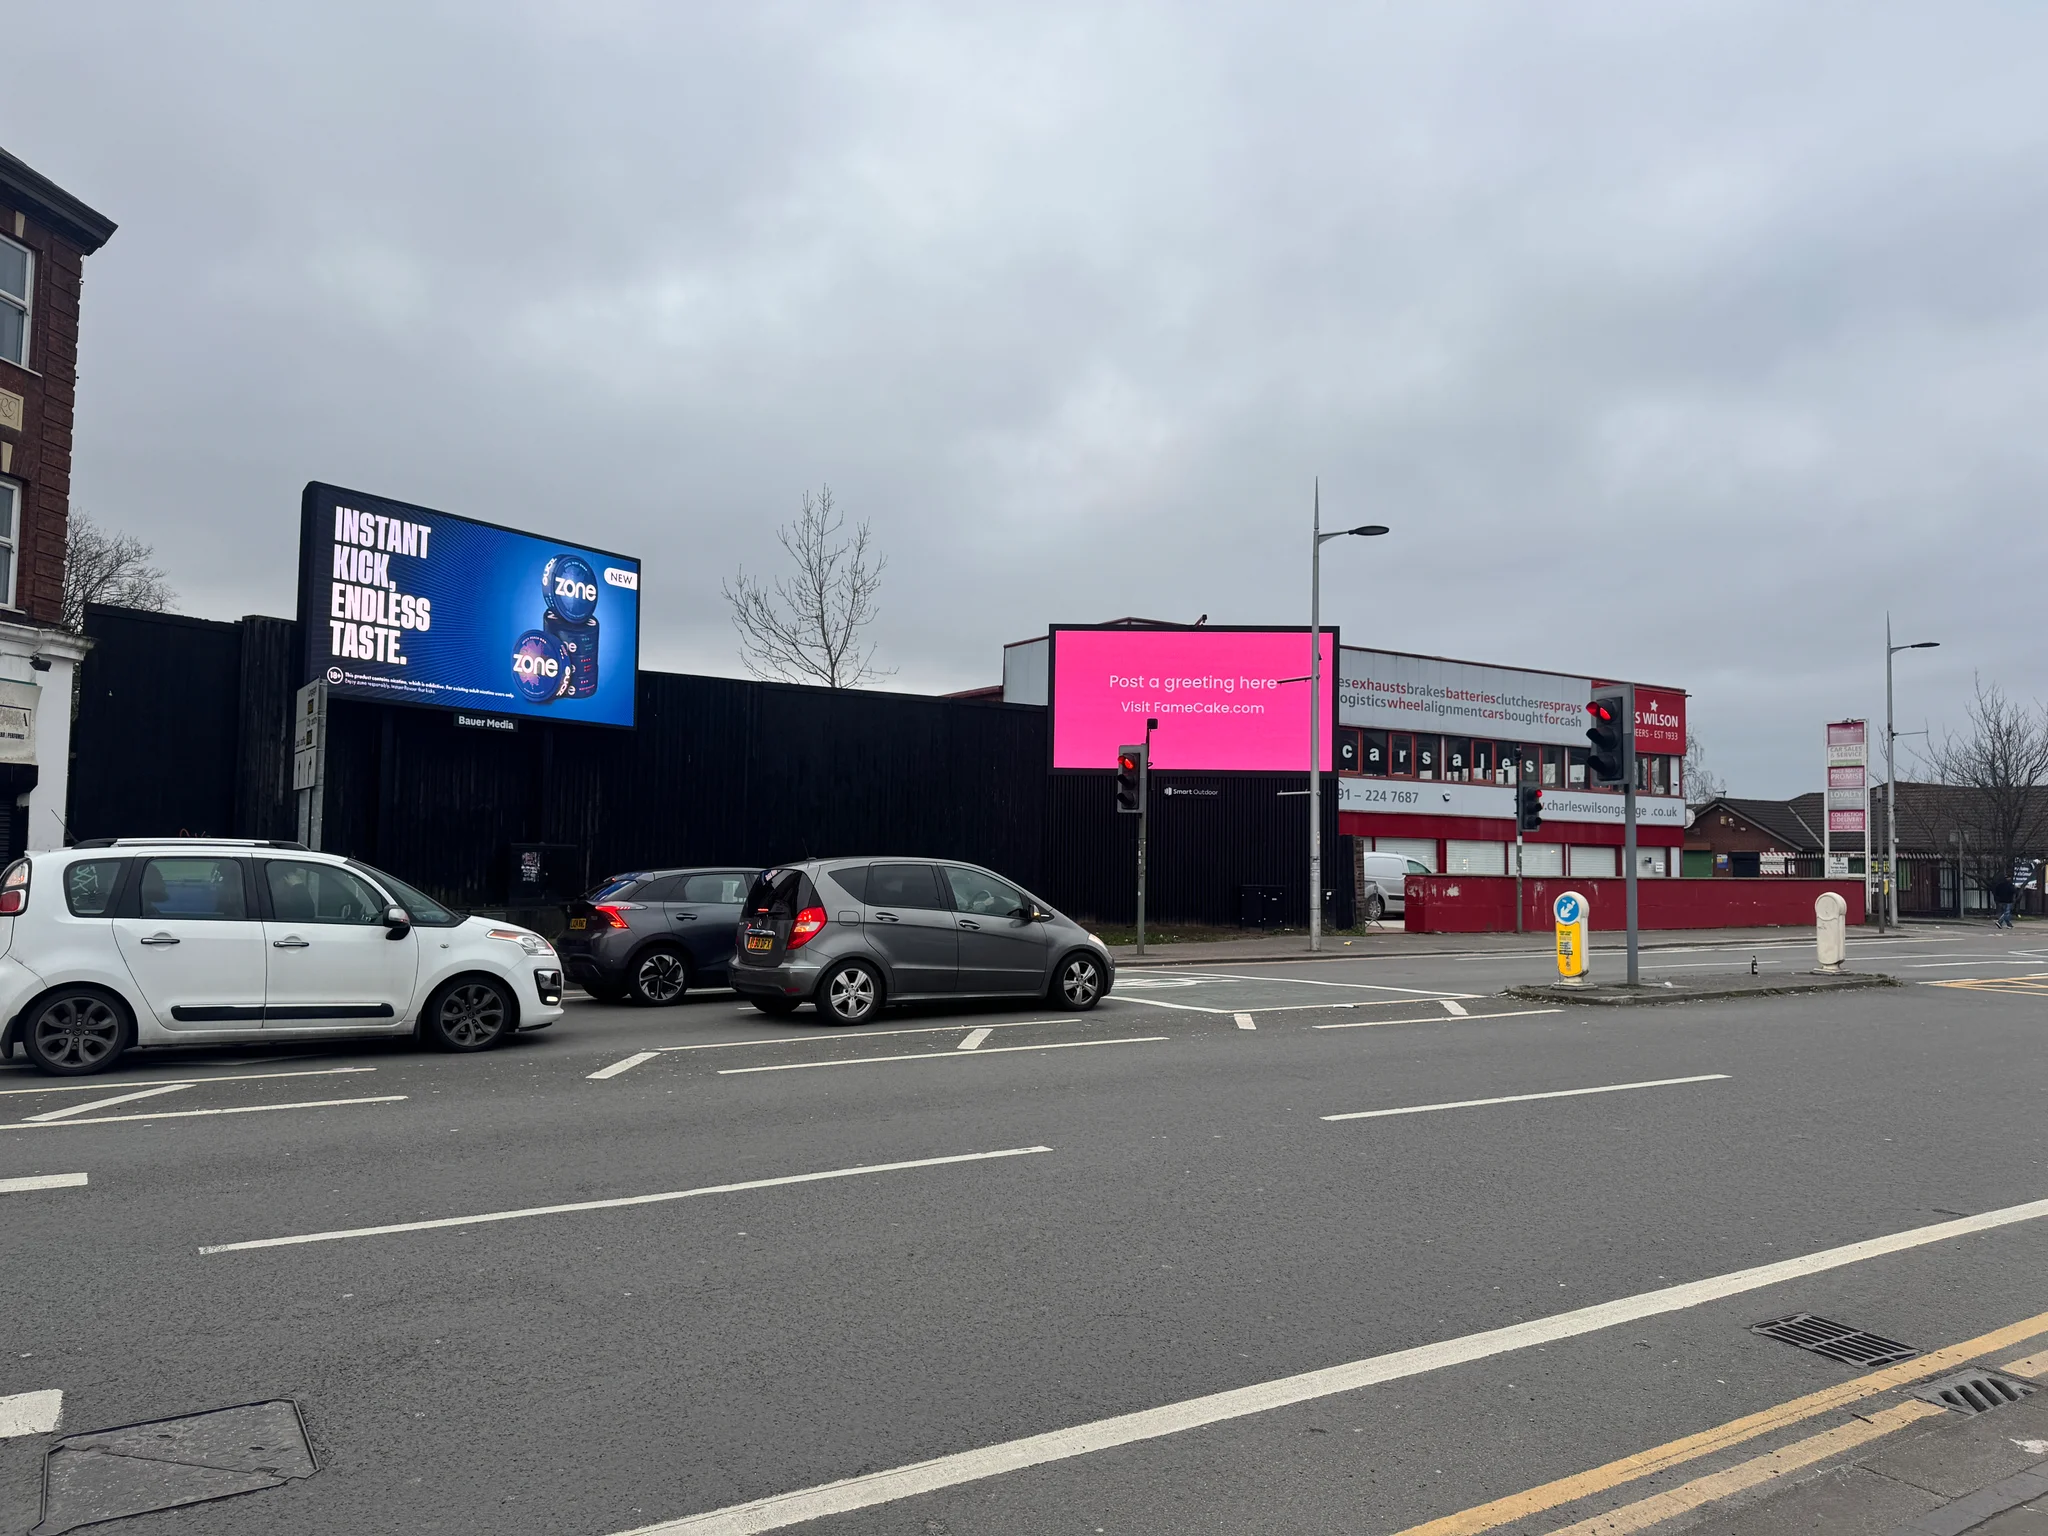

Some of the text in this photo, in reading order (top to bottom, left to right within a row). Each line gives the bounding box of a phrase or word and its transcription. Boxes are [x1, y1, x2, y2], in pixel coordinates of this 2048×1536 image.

[334, 505, 432, 560] INSTANT
[332, 543, 397, 593] KICK,
[610, 571, 633, 586] NEW
[555, 576, 597, 602] zone
[330, 581, 431, 632] ENDLESS
[329, 619, 408, 666] TASTE.
[513, 653, 559, 678] zone
[1109, 675, 1278, 694] Post a greeting here
[1121, 701, 1265, 715] Visit FameCake.com
[458, 715, 514, 730] Bauer Media
[1642, 712, 1679, 728] WILSON
[1654, 730, 1664, 739] EST
[1665, 731, 1679, 741] 1933
[1831, 772, 1864, 780] PROMISE
[1365, 789, 1388, 802] 224
[1390, 790, 1419, 804] 7687
[1650, 806, 1678, 817] .co.uk
